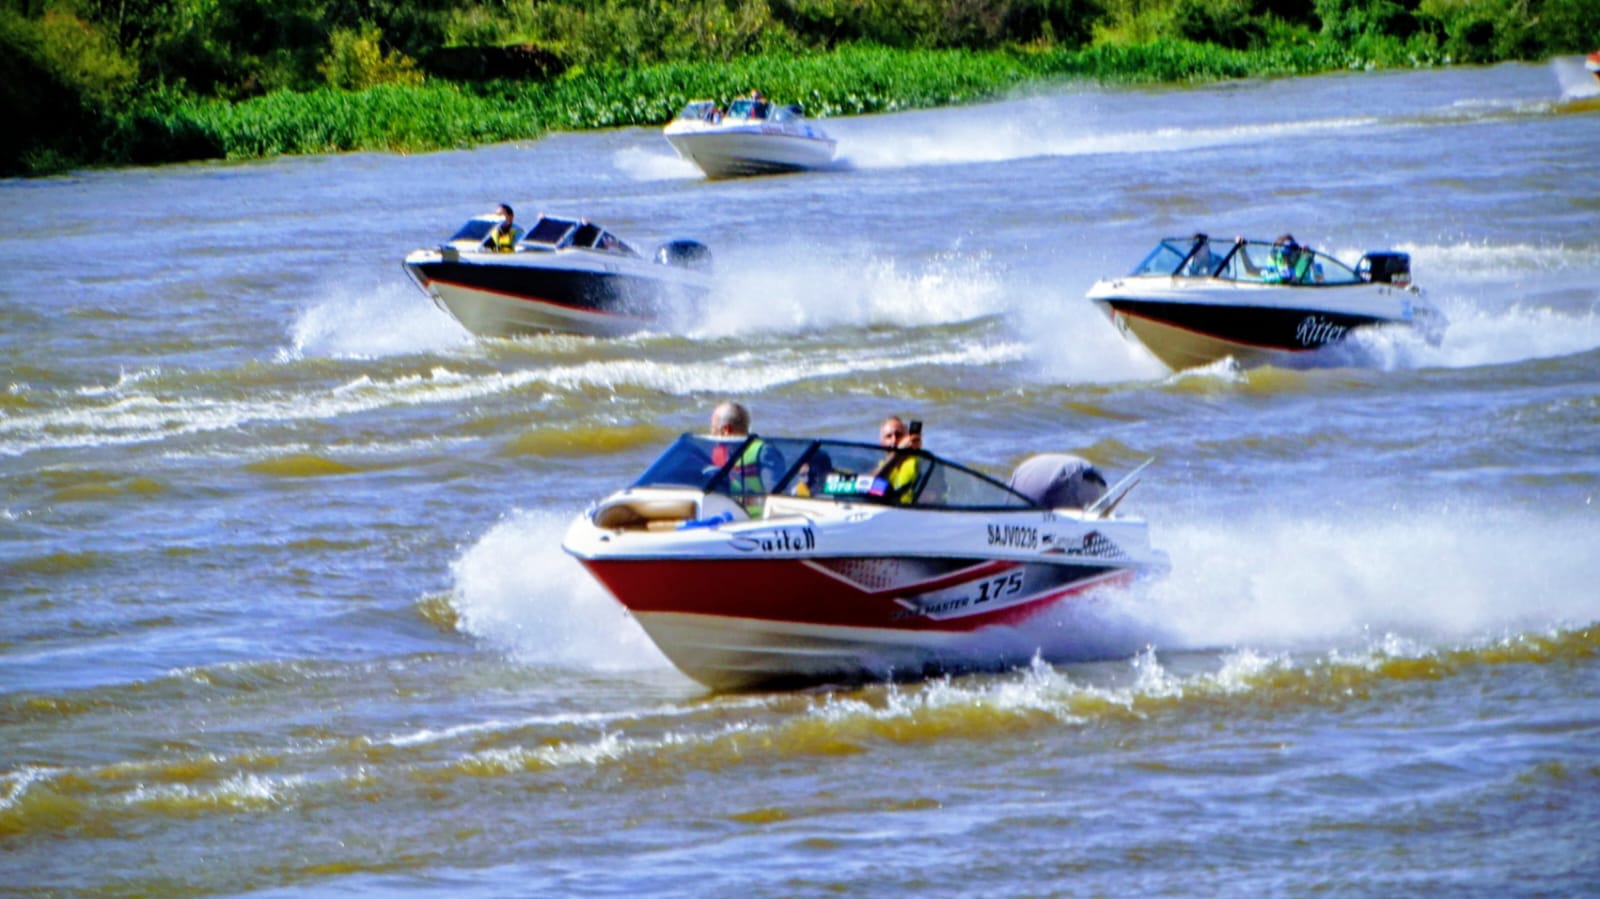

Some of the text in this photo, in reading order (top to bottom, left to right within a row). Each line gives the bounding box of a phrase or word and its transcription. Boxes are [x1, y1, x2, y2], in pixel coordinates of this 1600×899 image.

[987, 524, 1038, 550] SAJV0236
[925, 597, 970, 616] MASTER
[974, 572, 1024, 604] 175
